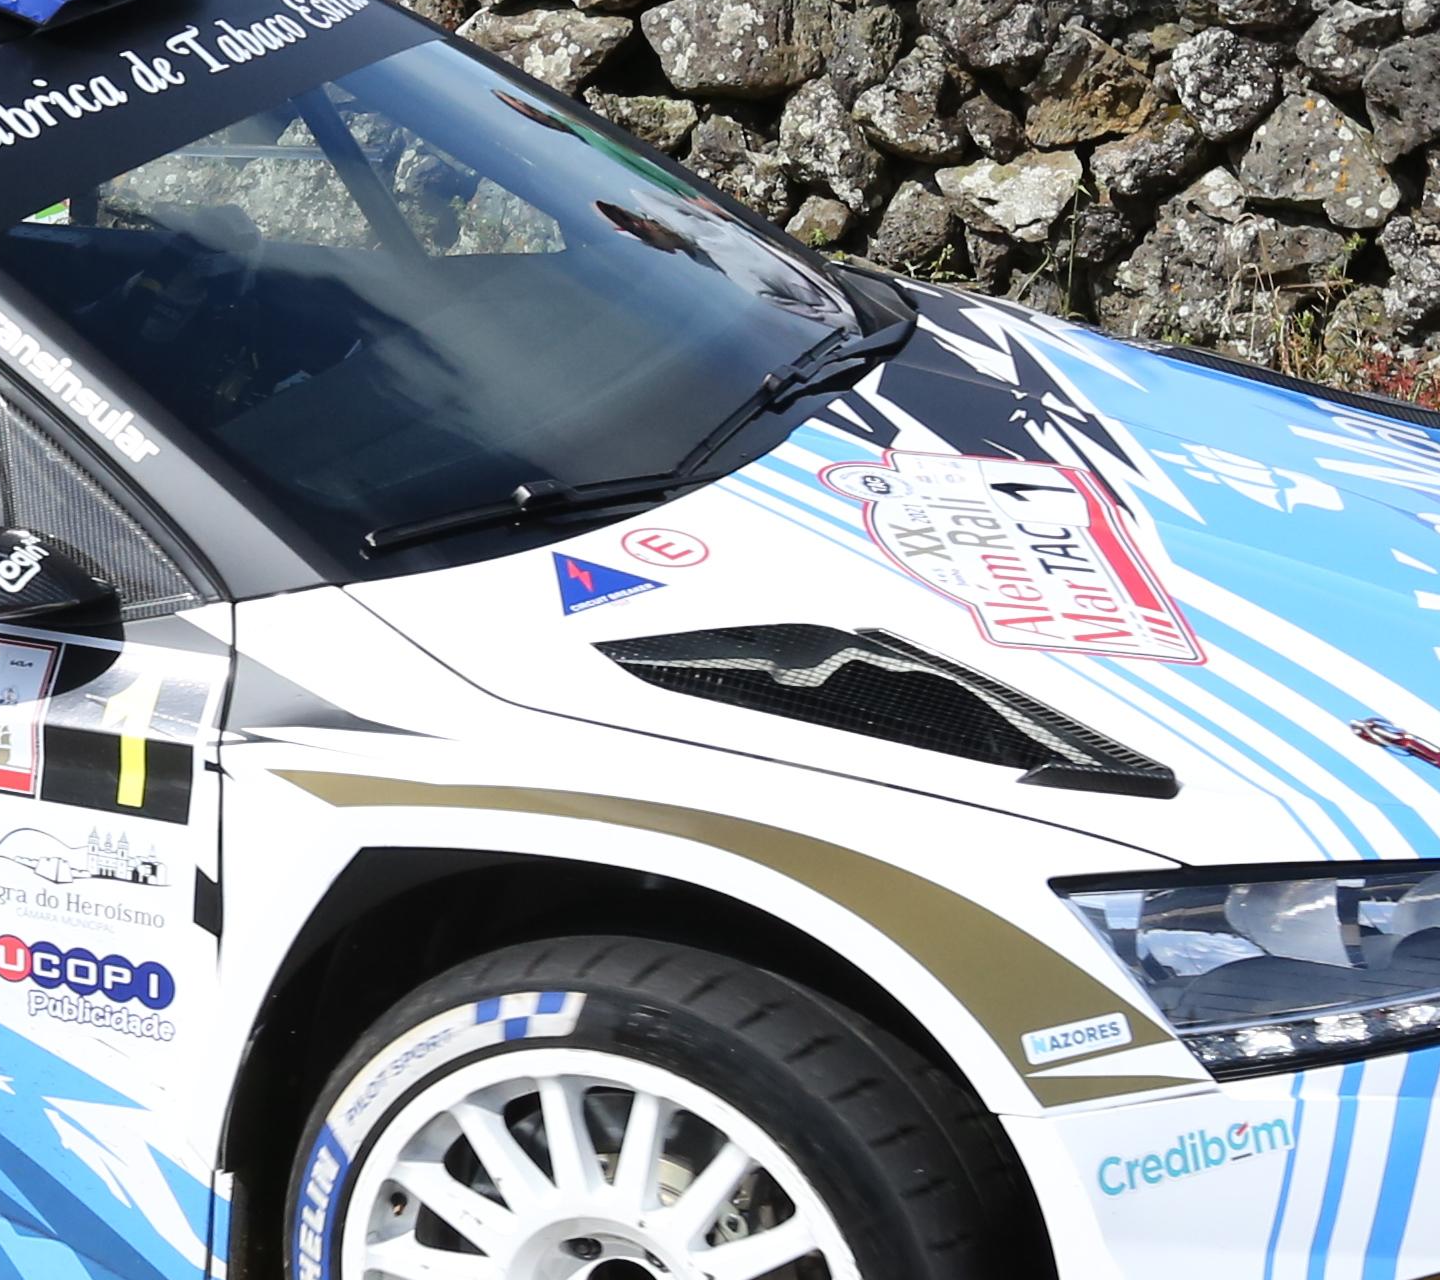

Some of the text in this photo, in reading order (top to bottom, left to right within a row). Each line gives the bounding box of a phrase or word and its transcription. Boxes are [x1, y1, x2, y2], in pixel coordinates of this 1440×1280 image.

[120, 50, 186, 95] de
[166, 13, 309, 75] Tabaco
[990, 482, 1077, 502] 1
[637, 534, 695, 561] E
[888, 523, 953, 561] XX
[921, 496, 1016, 551] Rali
[976, 553, 1067, 640] Além
[1016, 523, 1140, 647] Mar TAC
[100, 665, 164, 808] 1
[35, 888, 60, 909] do
[65, 892, 166, 929] Heroísmo
[28, 989, 177, 1042] Publicidade
[1049, 1021, 1121, 1051] AZORES
[345, 1070, 390, 1124] PILOT
[388, 1027, 453, 1078] SPORT
[1098, 1118, 1291, 1197] Credibom
